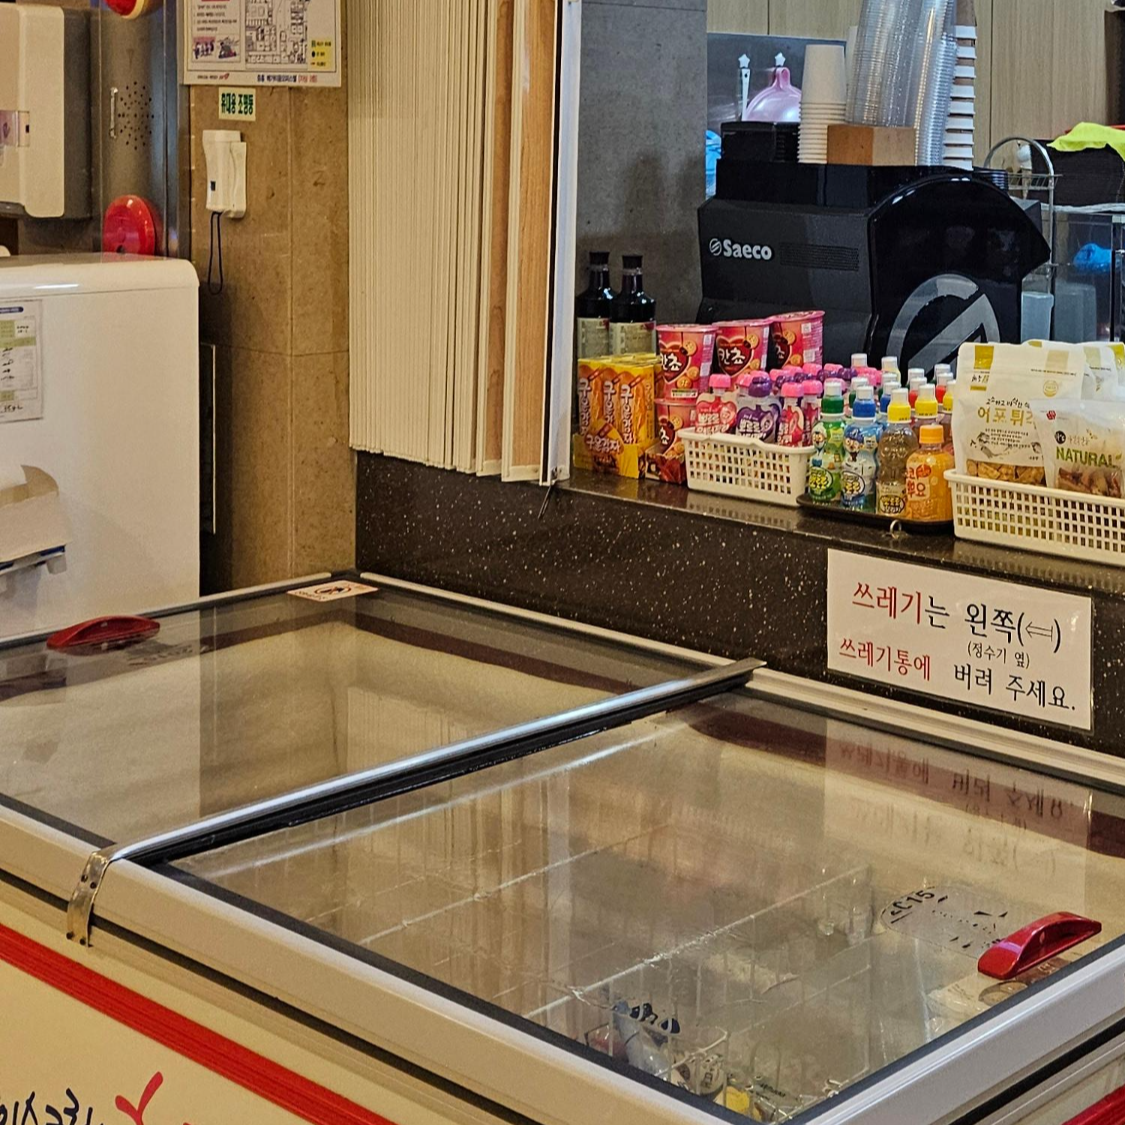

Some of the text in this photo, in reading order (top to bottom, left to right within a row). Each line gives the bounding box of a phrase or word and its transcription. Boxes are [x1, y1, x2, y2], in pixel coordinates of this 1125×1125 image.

[722, 238, 773, 261] Saeco
[718, 347, 746, 365] 칸쵸
[603, 381, 616, 424] 구운감
[1056, 446, 1117, 469] NATURAL
[852, 581, 950, 629] 쓰레기는
[839, 638, 1076, 711] 쓰레기통에 버려 주세요.
